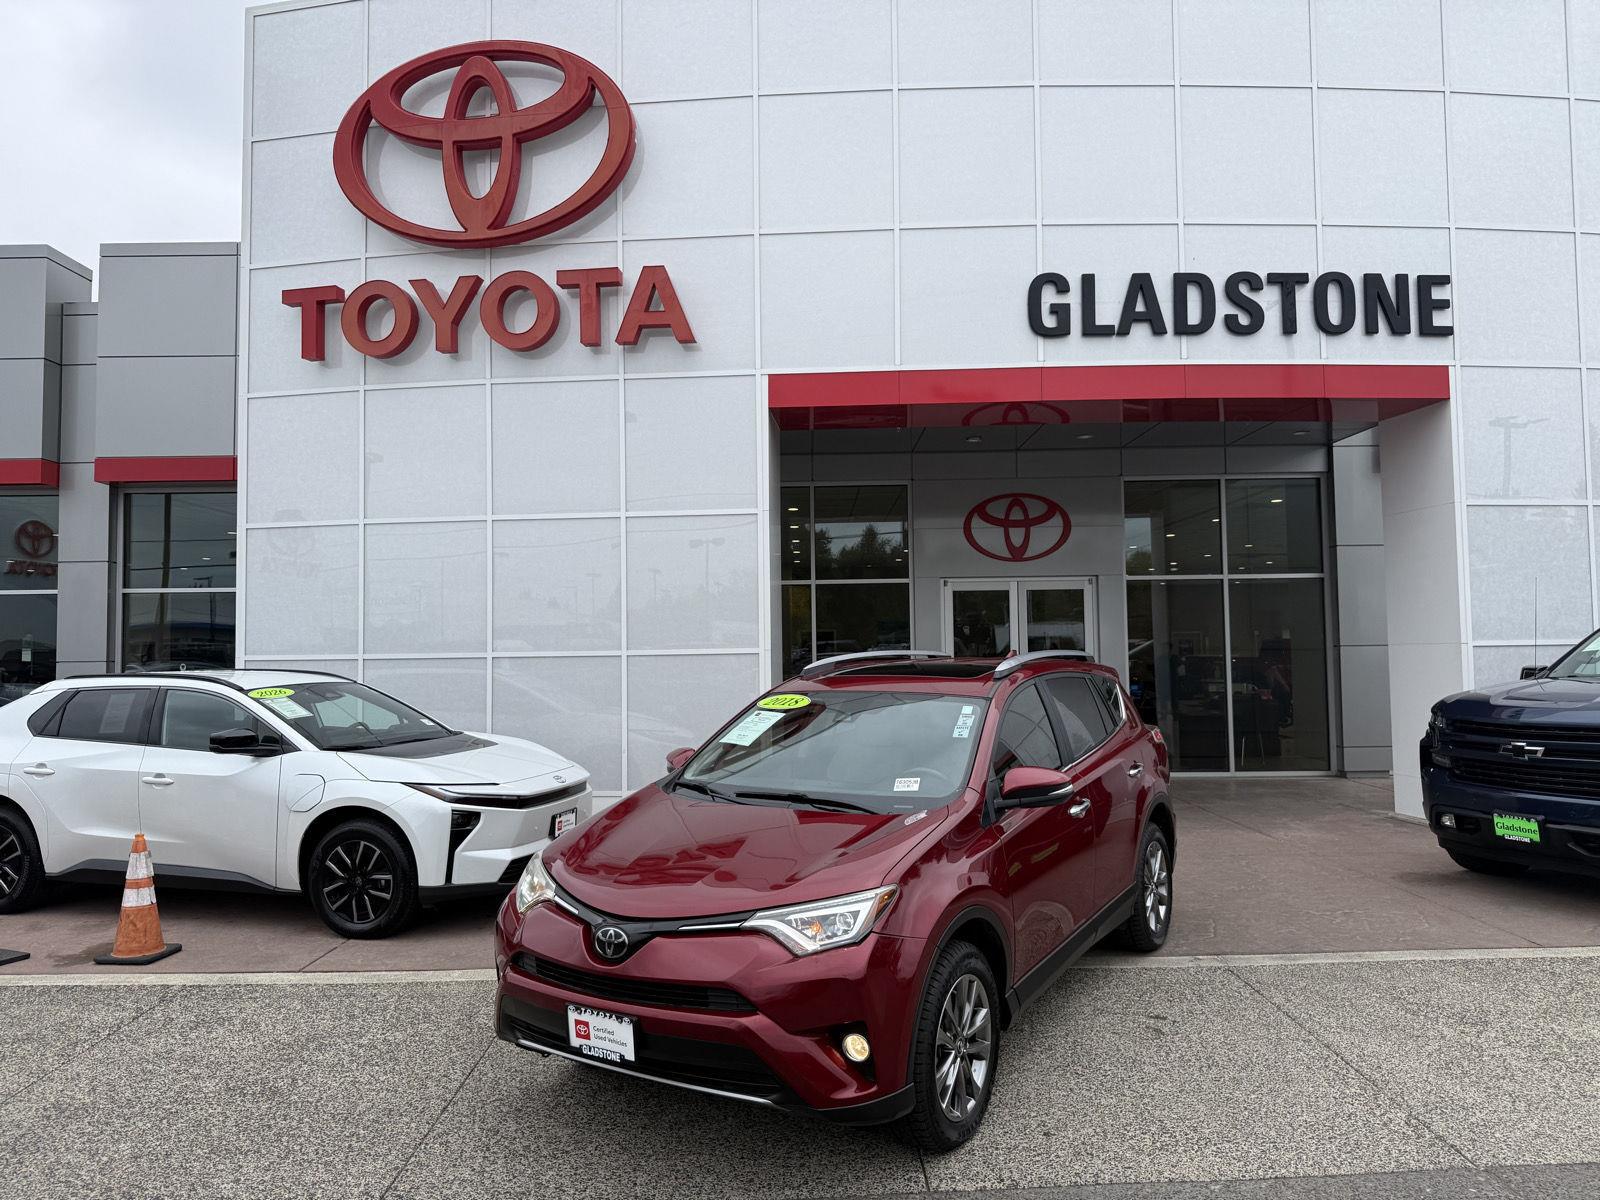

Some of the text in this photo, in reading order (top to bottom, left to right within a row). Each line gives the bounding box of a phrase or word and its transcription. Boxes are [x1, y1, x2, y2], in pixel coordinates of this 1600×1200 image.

[1027, 271, 1454, 337] GLADSTONE
[282, 265, 696, 362] TOYOTA
[256, 689, 287, 698] 2026
[762, 697, 806, 707] 2018
[1495, 821, 1538, 835] Gladstone
[1504, 834, 1531, 843] GLADSTONE
[581, 1008, 617, 1021] TOYOTA
[593, 1025, 614, 1036] Certified
[594, 1033, 628, 1047] Used Vehicles
[582, 1044, 621, 1062] GLADSTONE
